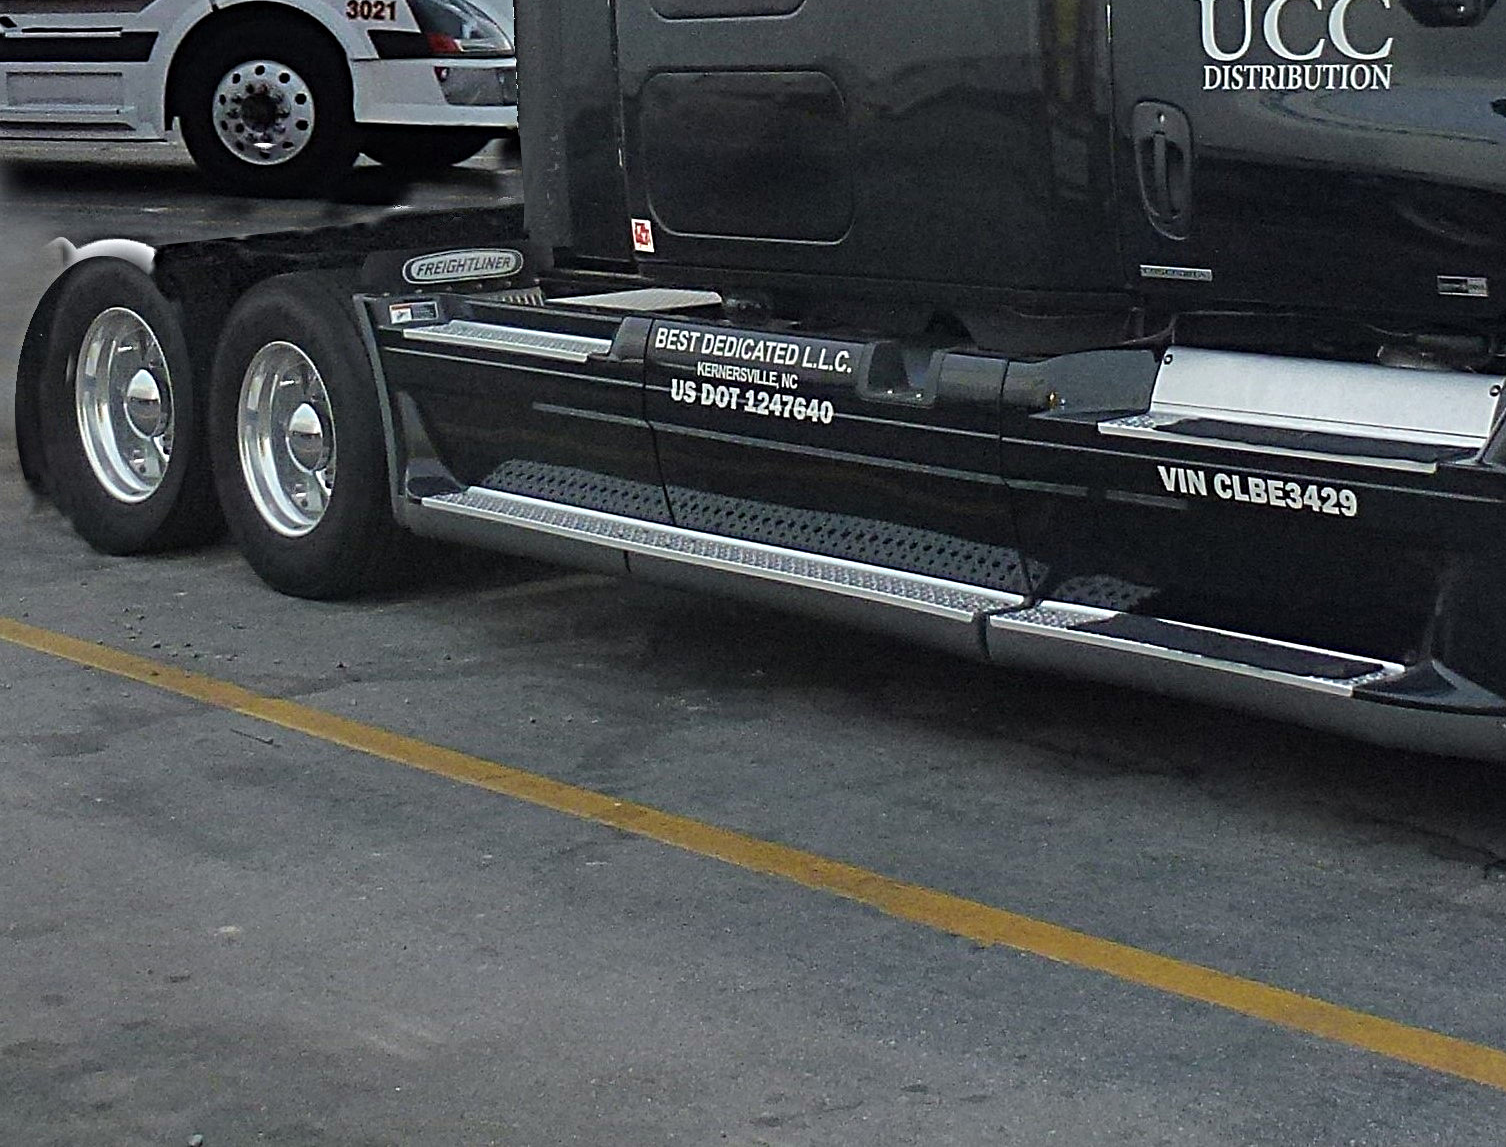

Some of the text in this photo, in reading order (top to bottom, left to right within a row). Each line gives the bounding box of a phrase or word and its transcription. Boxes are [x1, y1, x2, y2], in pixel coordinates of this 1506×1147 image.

[346, 0, 397, 21] 3021
[1203, 63, 1393, 90] DISTRIBUTION
[416, 257, 511, 276] FREIGHTLINER
[655, 328, 852, 374] BEST DEDICATED L.L.C.
[697, 361, 799, 390] KERNERSVILLE, NC
[671, 379, 834, 424] US DOT 1247640
[1157, 465, 1358, 517] VIN CLBE3429
